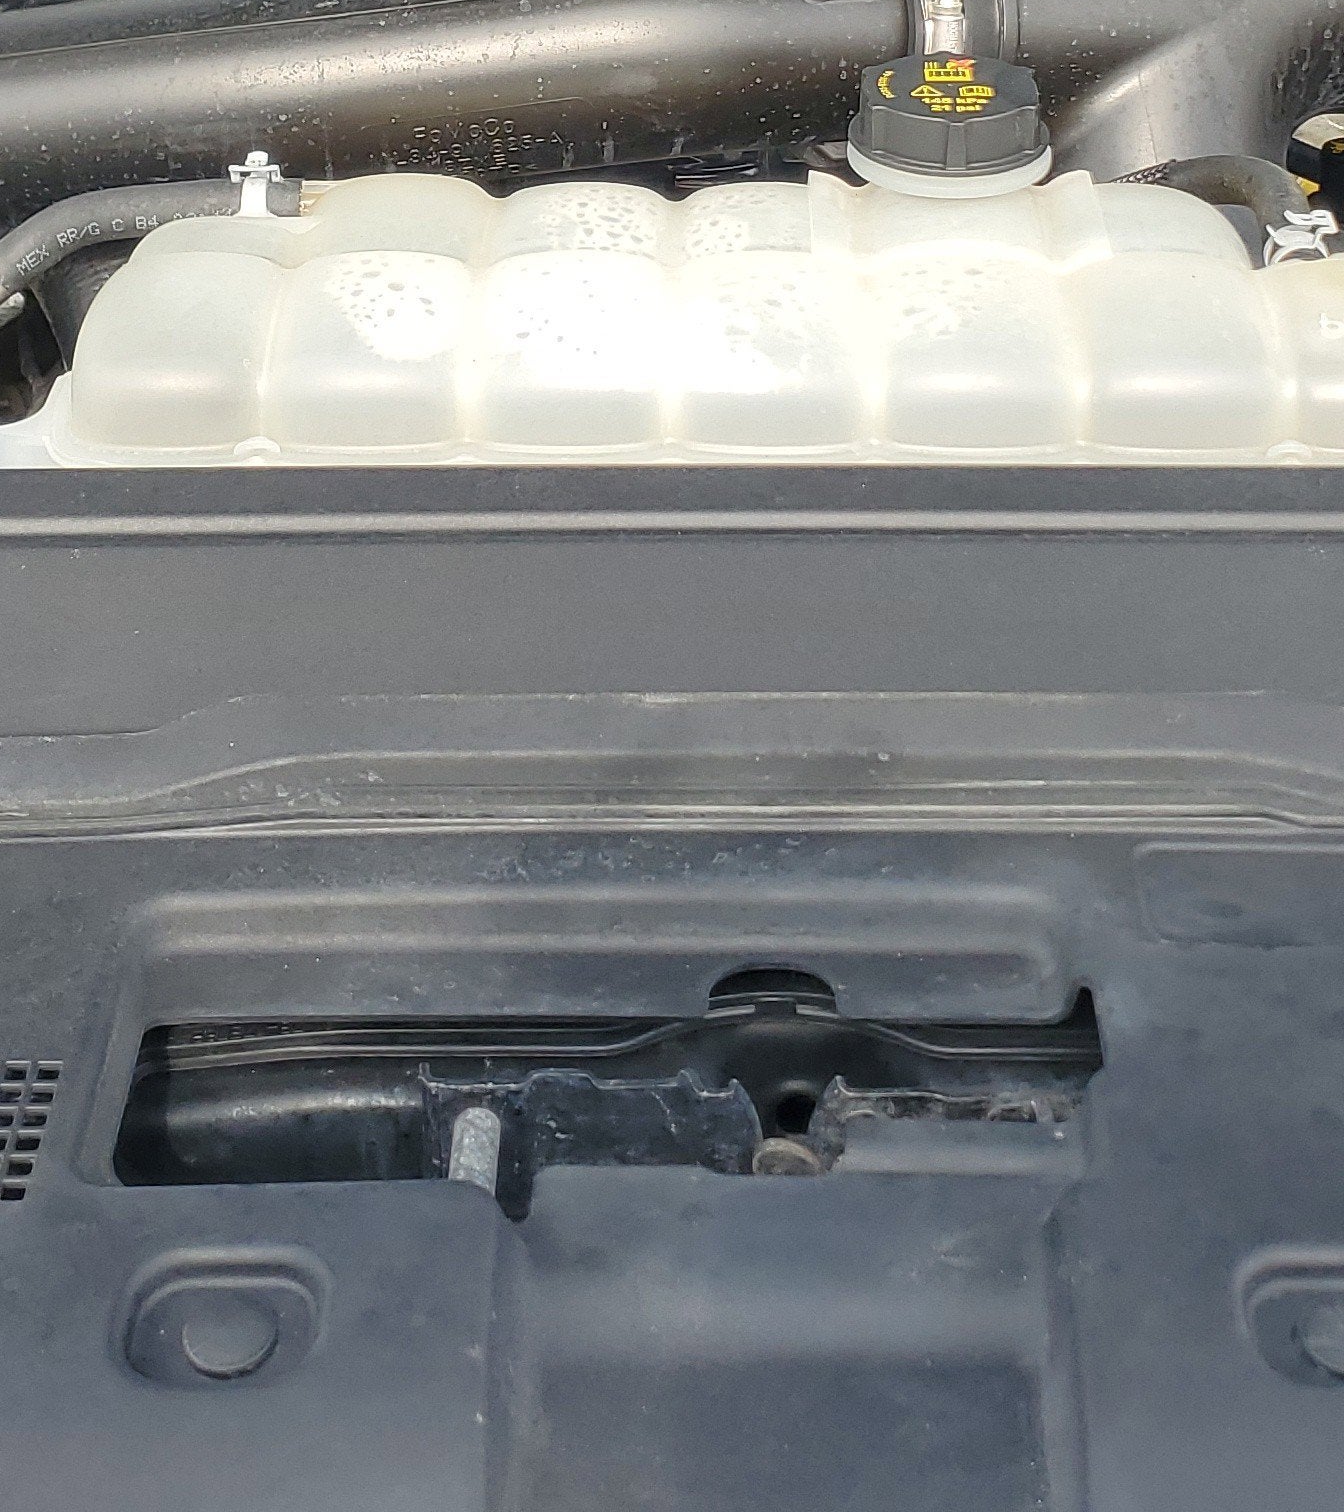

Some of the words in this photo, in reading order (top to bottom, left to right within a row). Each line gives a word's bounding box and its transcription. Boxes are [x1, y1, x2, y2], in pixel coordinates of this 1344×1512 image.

[16, 244, 50, 276] MEX
[56, 221, 102, 249] RR/G
[112, 219, 125, 231] C
[136, 214, 160, 231] B4
